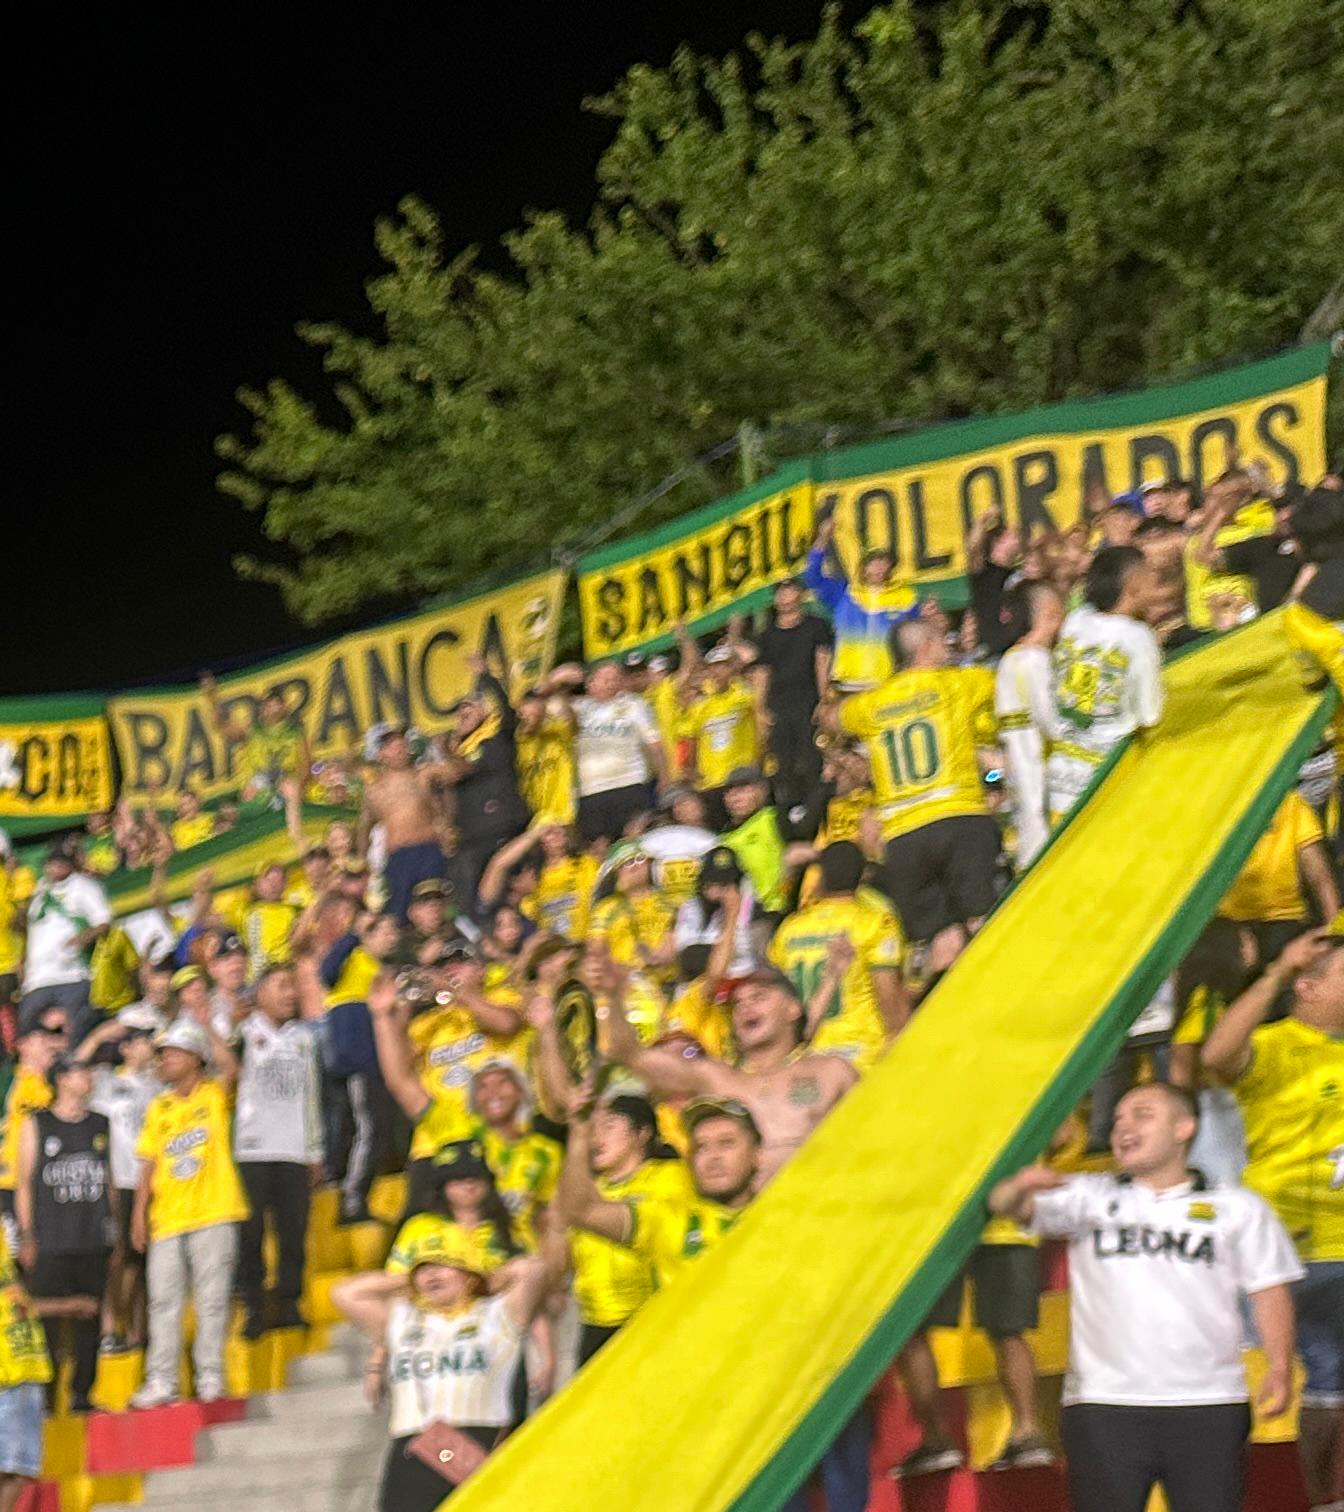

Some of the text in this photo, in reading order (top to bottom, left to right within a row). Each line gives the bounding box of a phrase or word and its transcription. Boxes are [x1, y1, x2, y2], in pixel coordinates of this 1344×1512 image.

[597, 500, 812, 641] SANGIL
[880, 717, 941, 791] 10
[1093, 1224, 1215, 1268] LEONA
[390, 1342, 488, 1384] EONA
